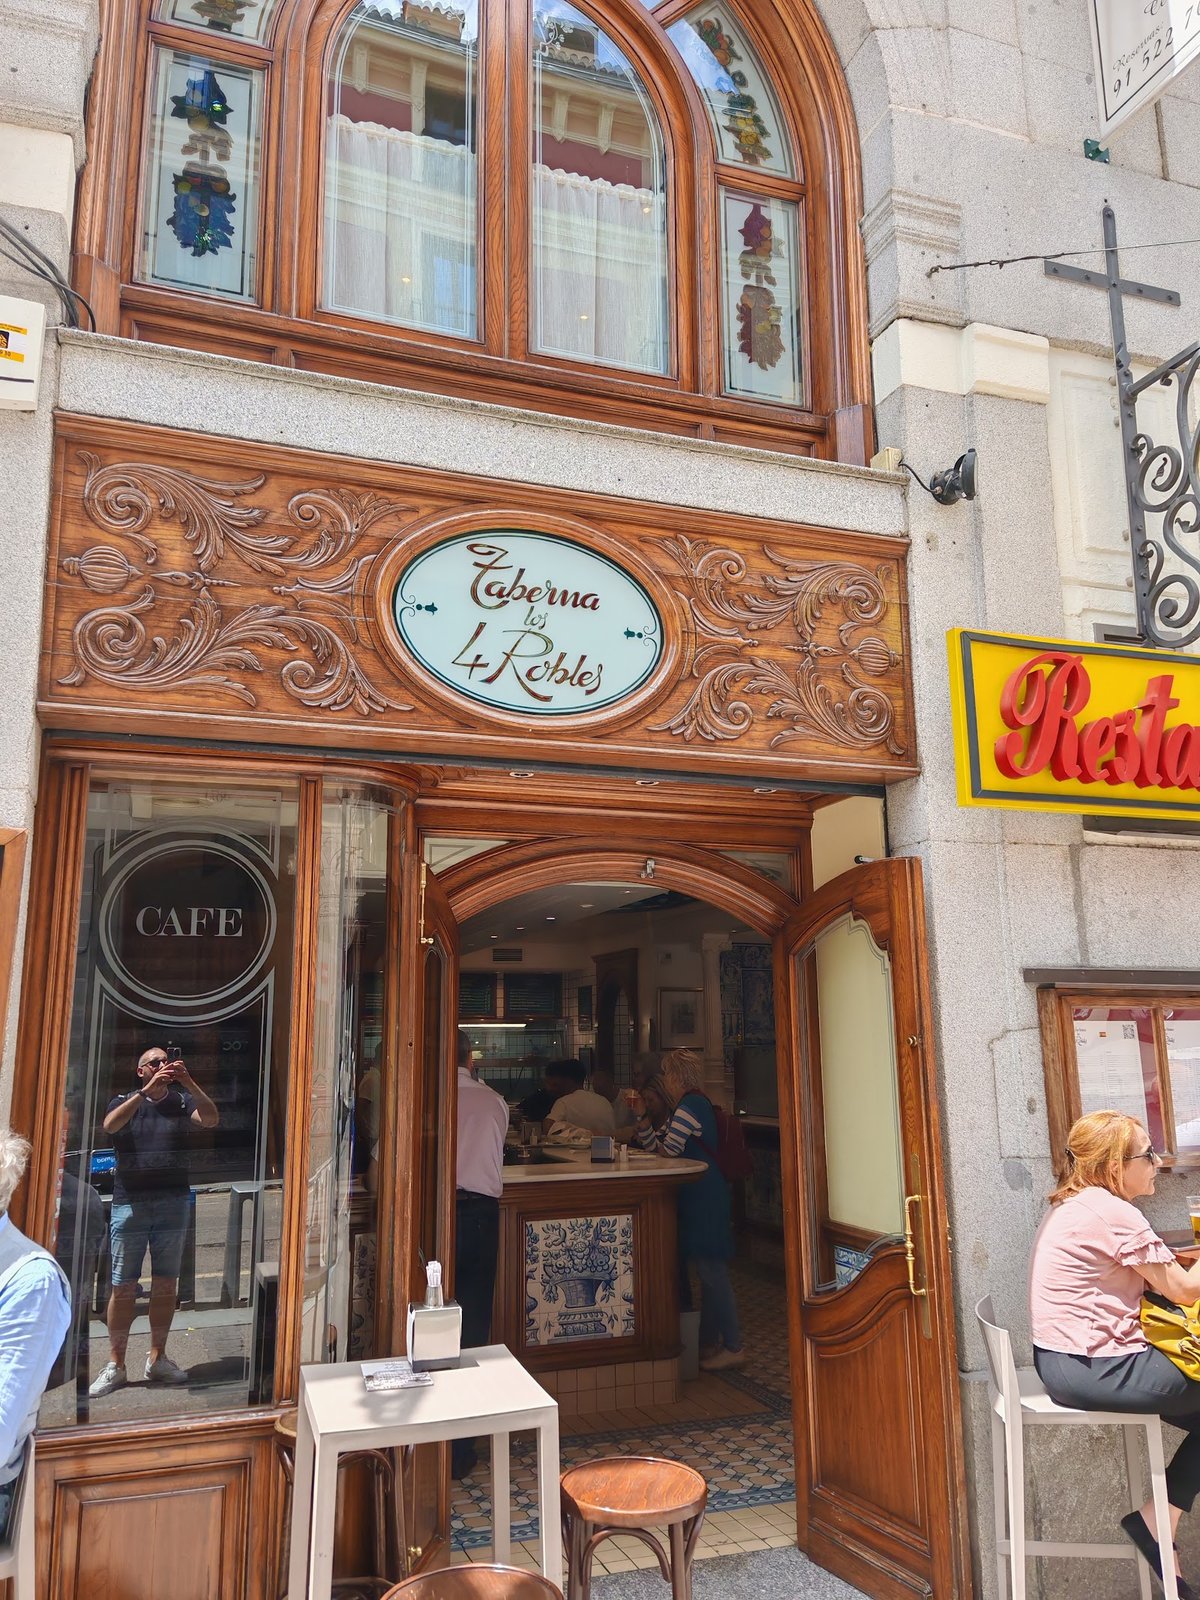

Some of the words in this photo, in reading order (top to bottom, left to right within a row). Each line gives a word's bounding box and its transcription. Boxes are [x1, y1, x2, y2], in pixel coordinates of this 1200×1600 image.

[1113, 67, 1131, 98] 91
[1142, 26, 1174, 72] 522
[466, 543, 600, 611] Taberna
[523, 605, 548, 630] los
[451, 621, 490, 680] 4
[478, 628, 603, 702] Robles
[135, 905, 243, 937] CAFE
